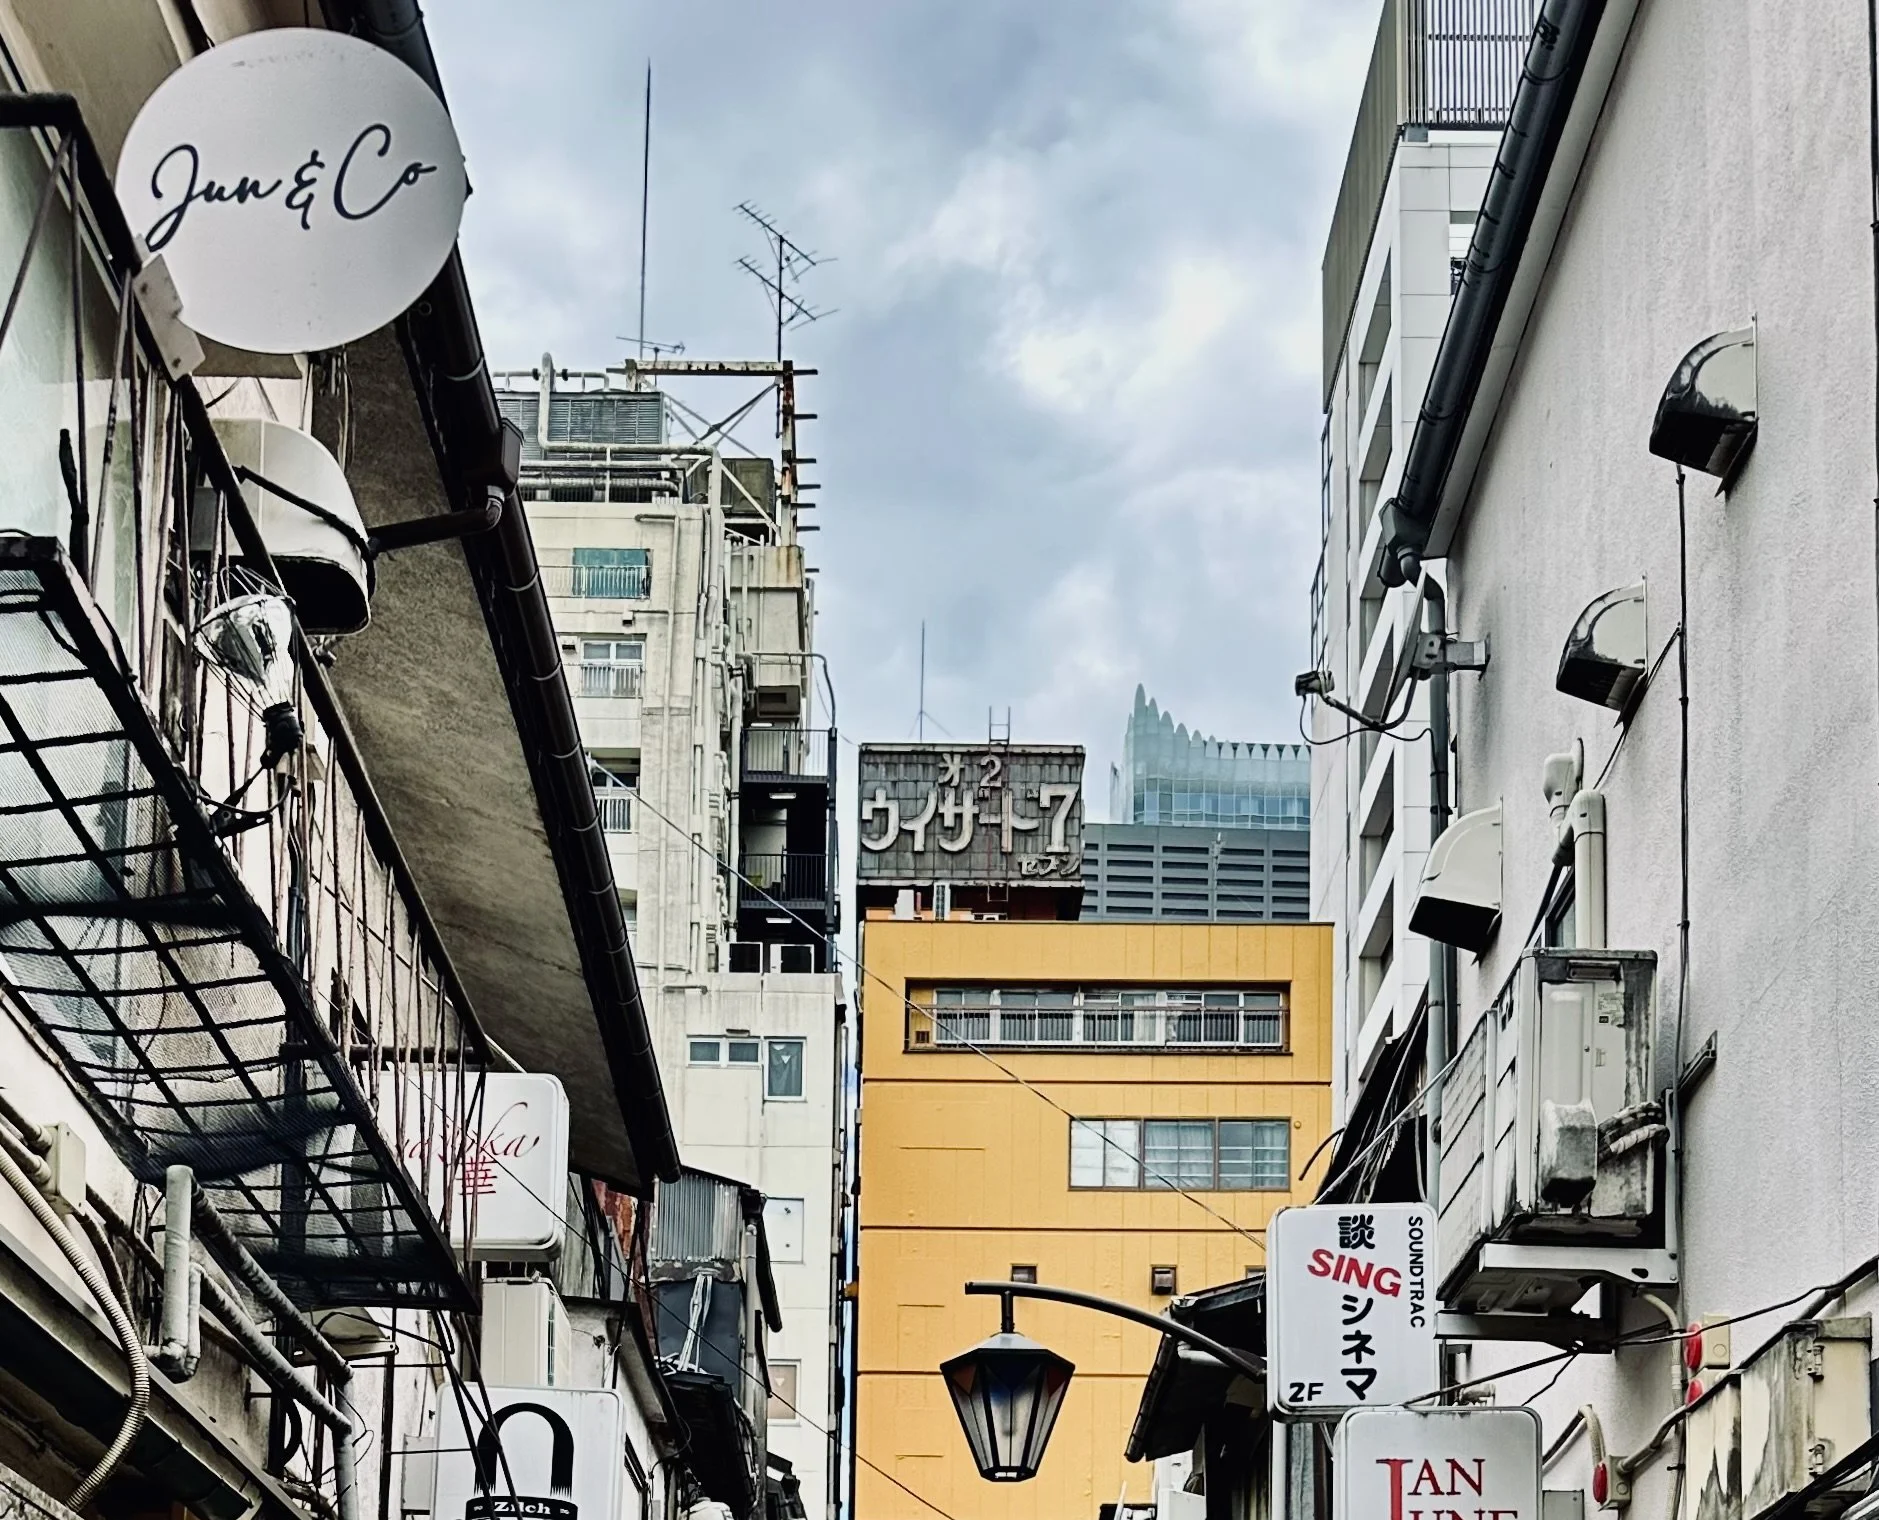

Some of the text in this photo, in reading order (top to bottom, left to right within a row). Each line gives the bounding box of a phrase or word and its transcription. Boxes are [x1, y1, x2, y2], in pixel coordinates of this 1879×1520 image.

[145, 143, 282, 252] Jun
[334, 123, 437, 220] Co
[1307, 1248, 1402, 1298] SING
[1408, 1215, 1426, 1328] SOUNDTRAC
[1288, 1382, 1324, 1402] 2F
